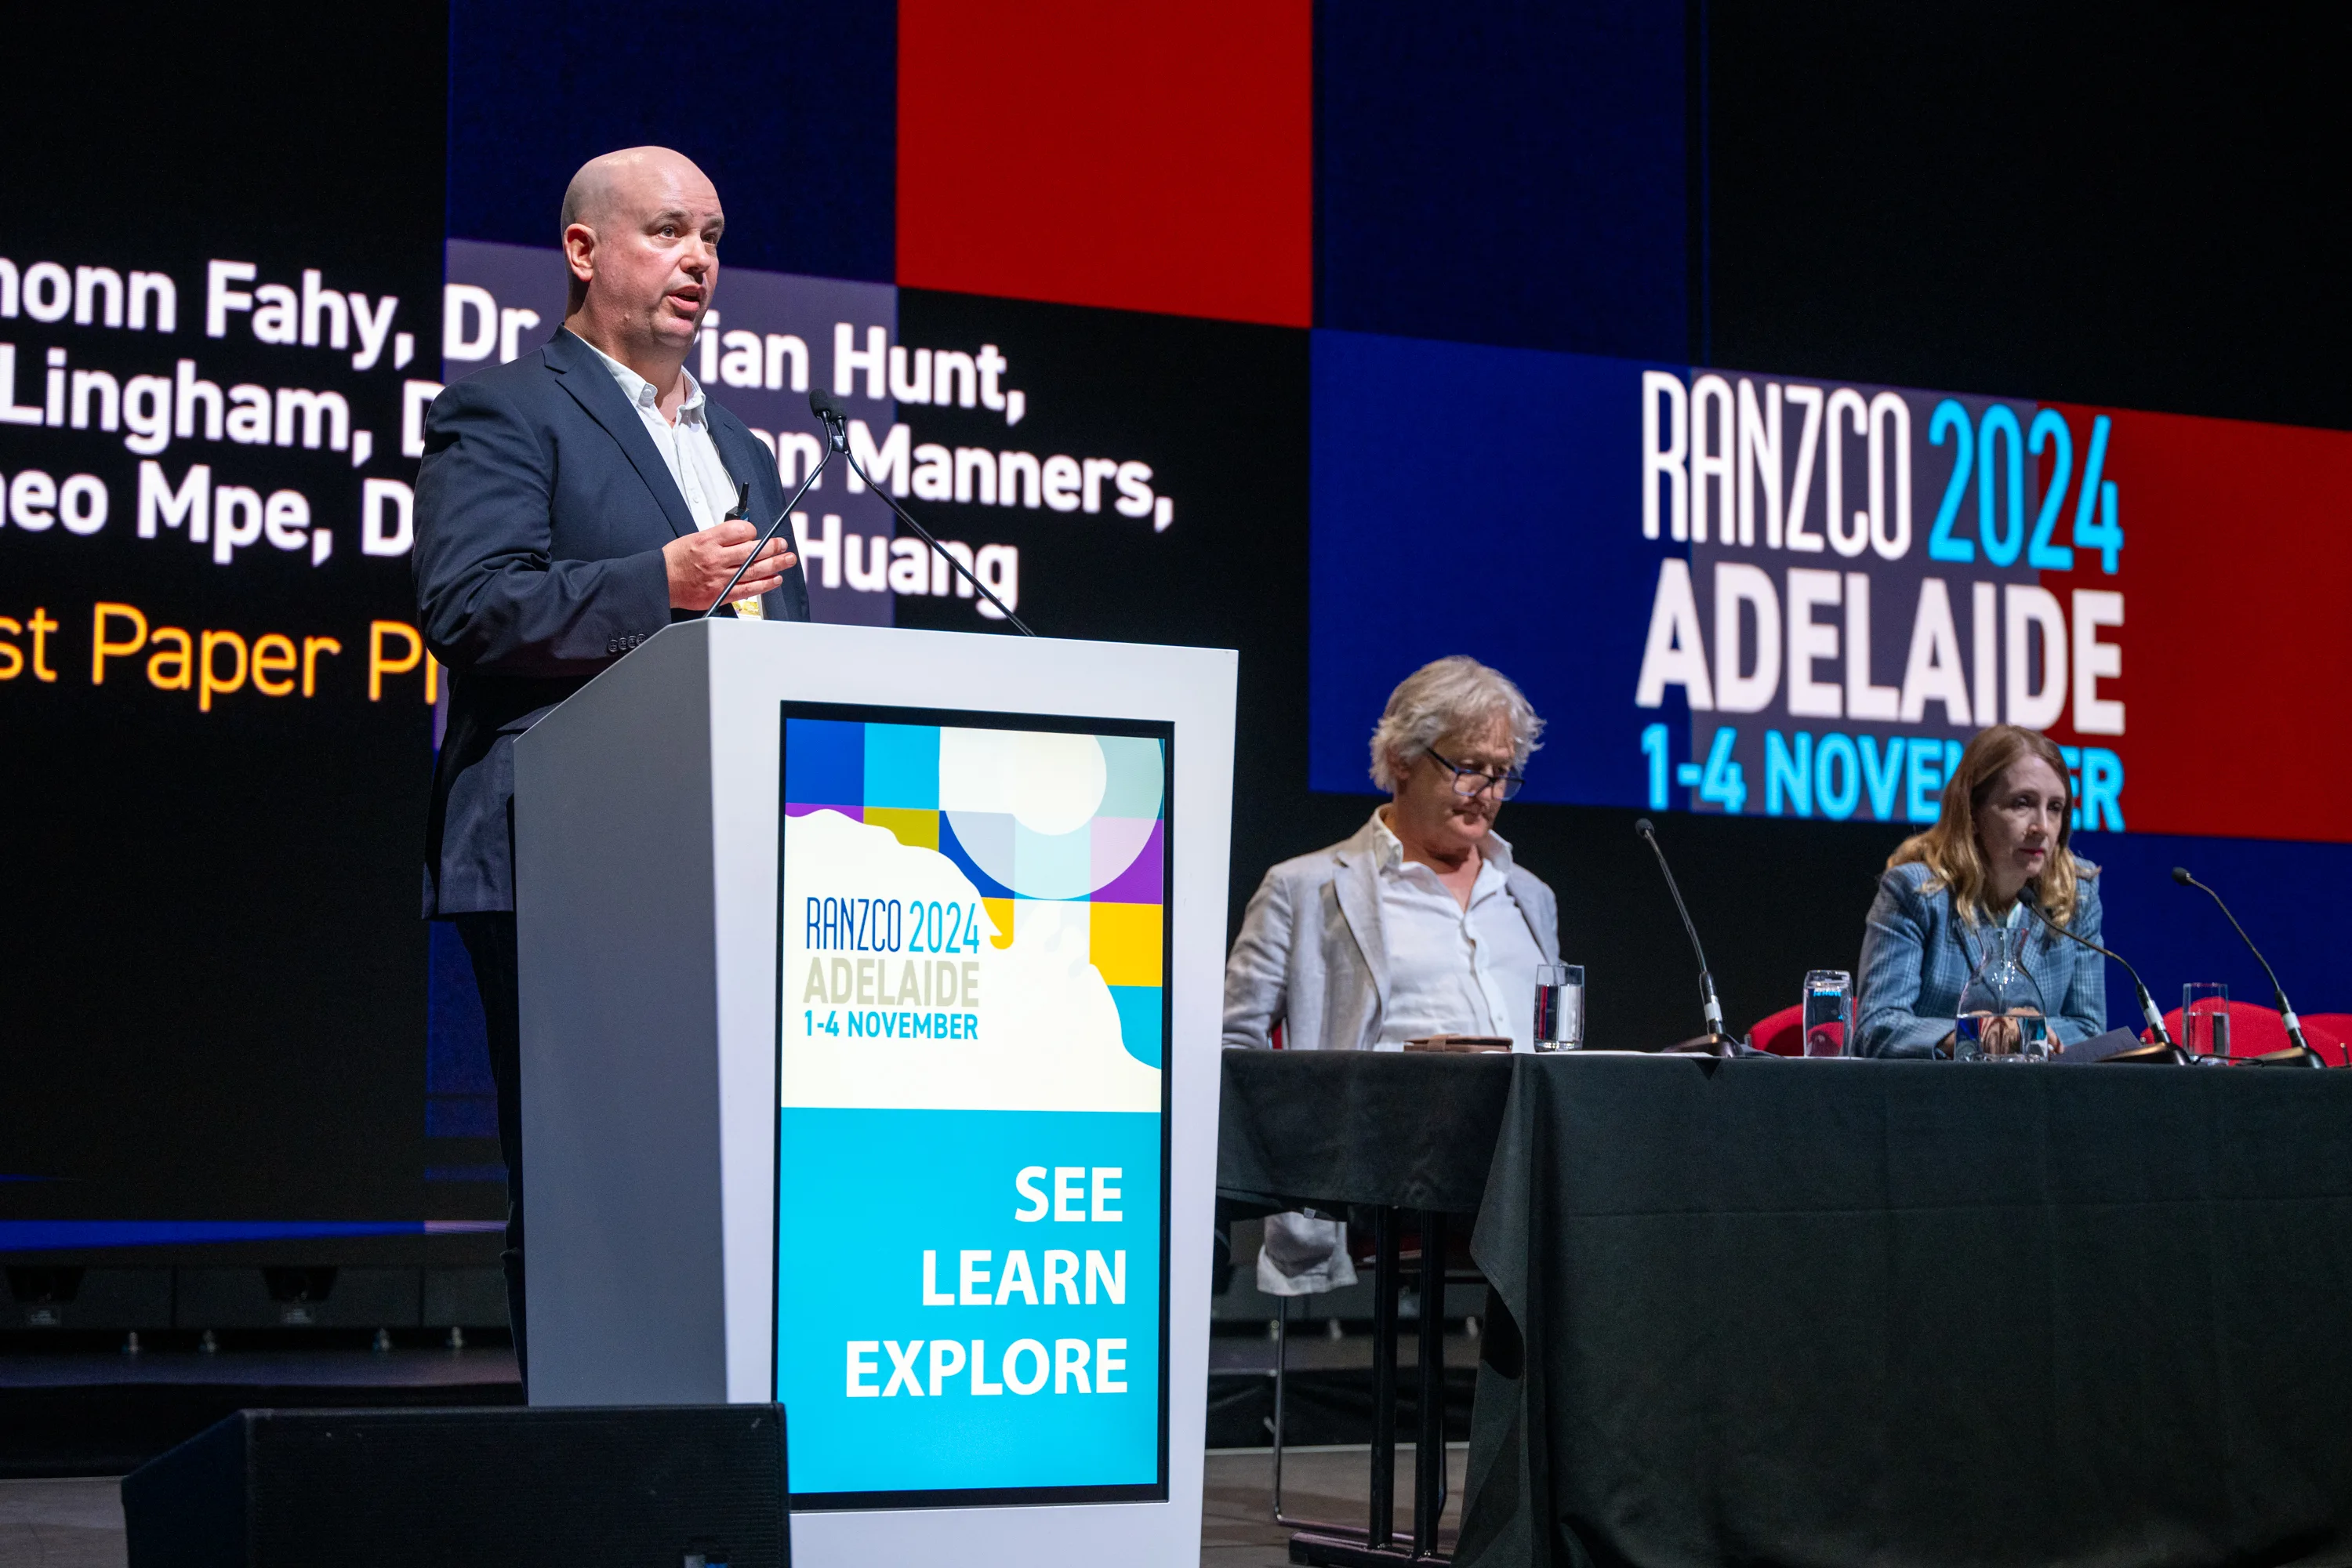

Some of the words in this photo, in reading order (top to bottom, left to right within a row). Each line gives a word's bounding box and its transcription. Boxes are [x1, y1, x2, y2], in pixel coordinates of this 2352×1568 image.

[206, 260, 414, 369] Fahy,
[443, 283, 541, 365] Dr
[833, 321, 1025, 425] Hunt,
[0, 343, 372, 466] Lingham,
[847, 419, 1173, 532] Manners,
[1642, 370, 1912, 561] RANZCO
[1928, 398, 2124, 574] 2024
[138, 459, 332, 565] Mpe,
[790, 510, 1018, 619] Huang
[91, 601, 342, 713] Paper
[1636, 558, 2125, 735] ADELAIDE
[1641, 722, 1747, 815] 1-4
[1764, 728, 2125, 833] NOVER
[806, 896, 902, 953] RANZCO
[909, 900, 980, 954] 2024
[803, 956, 980, 1007] ADELAIDE
[804, 1009, 840, 1037] 1-4
[848, 1011, 978, 1040] NOVEMBER
[1014, 1165, 1123, 1223] SEE
[922, 1249, 1127, 1307] LEARN
[845, 1338, 1128, 1399] EXPLORE
